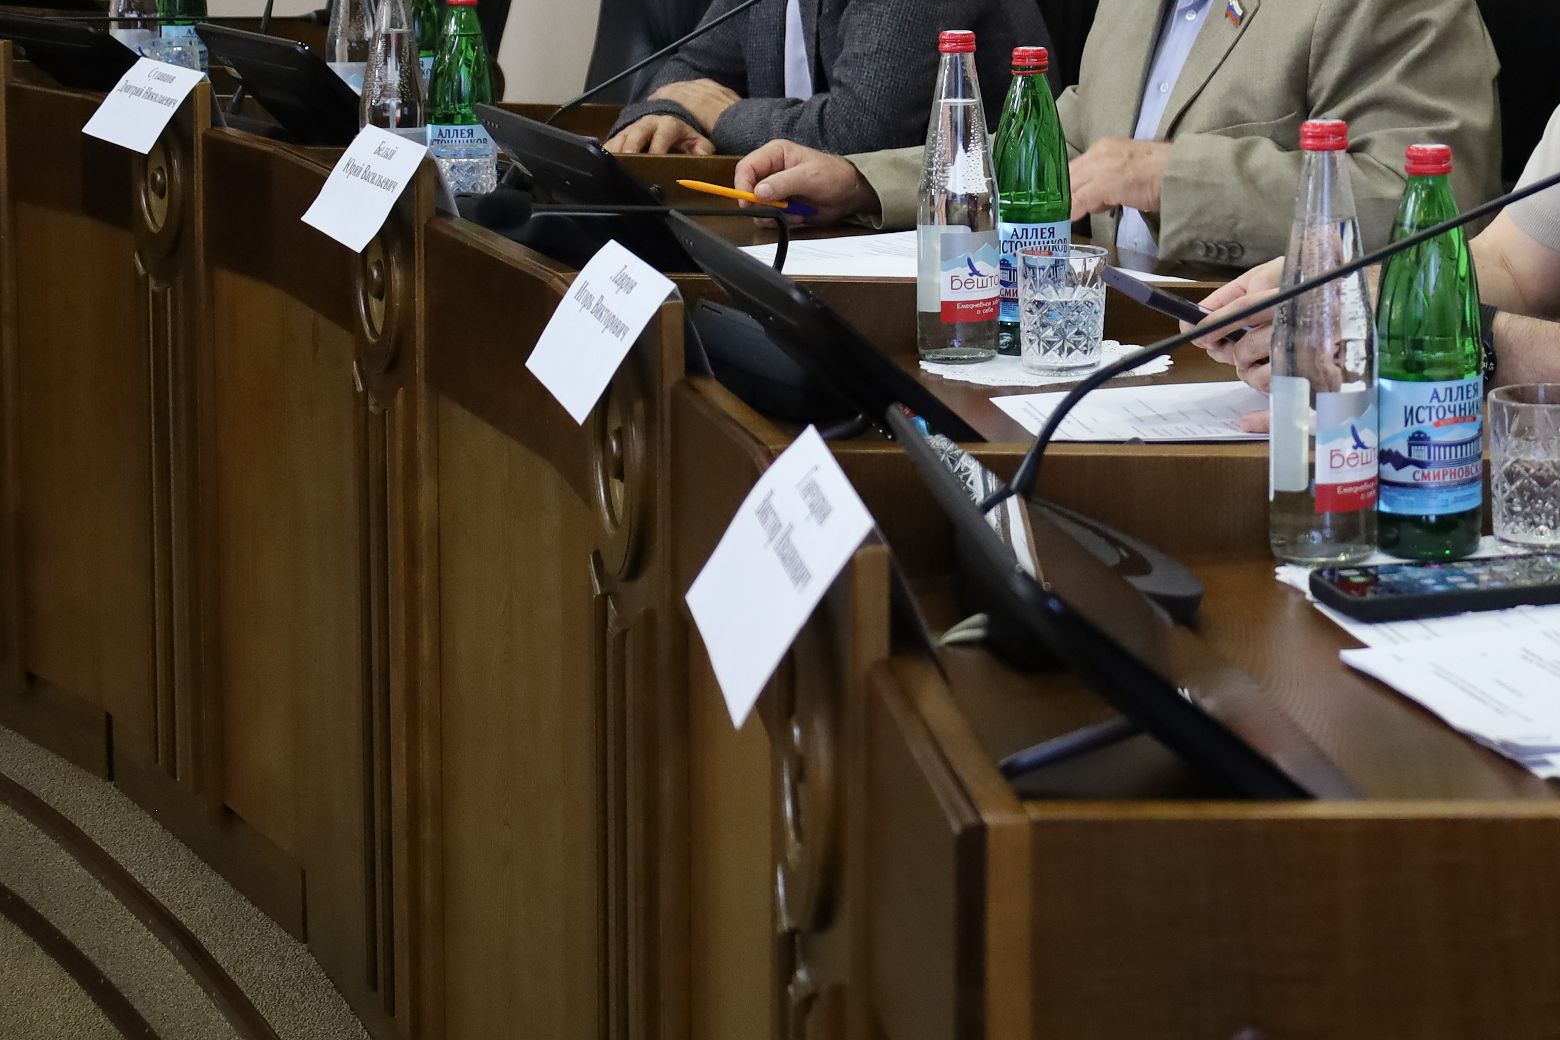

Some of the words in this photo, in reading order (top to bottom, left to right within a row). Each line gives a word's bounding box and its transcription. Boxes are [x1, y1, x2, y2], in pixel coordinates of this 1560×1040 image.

[437, 128, 474, 139] АЛЛЕЯ
[373, 140, 399, 161] Белый
[342, 157, 365, 179] Юрий
[359, 164, 399, 193] Васильевич
[1010, 226, 1056, 240] АЛЛЕЯ
[573, 280, 595, 313] Игорь
[590, 294, 630, 342] Викторович
[1429, 382, 1479, 403] АЛЛЕЯ
